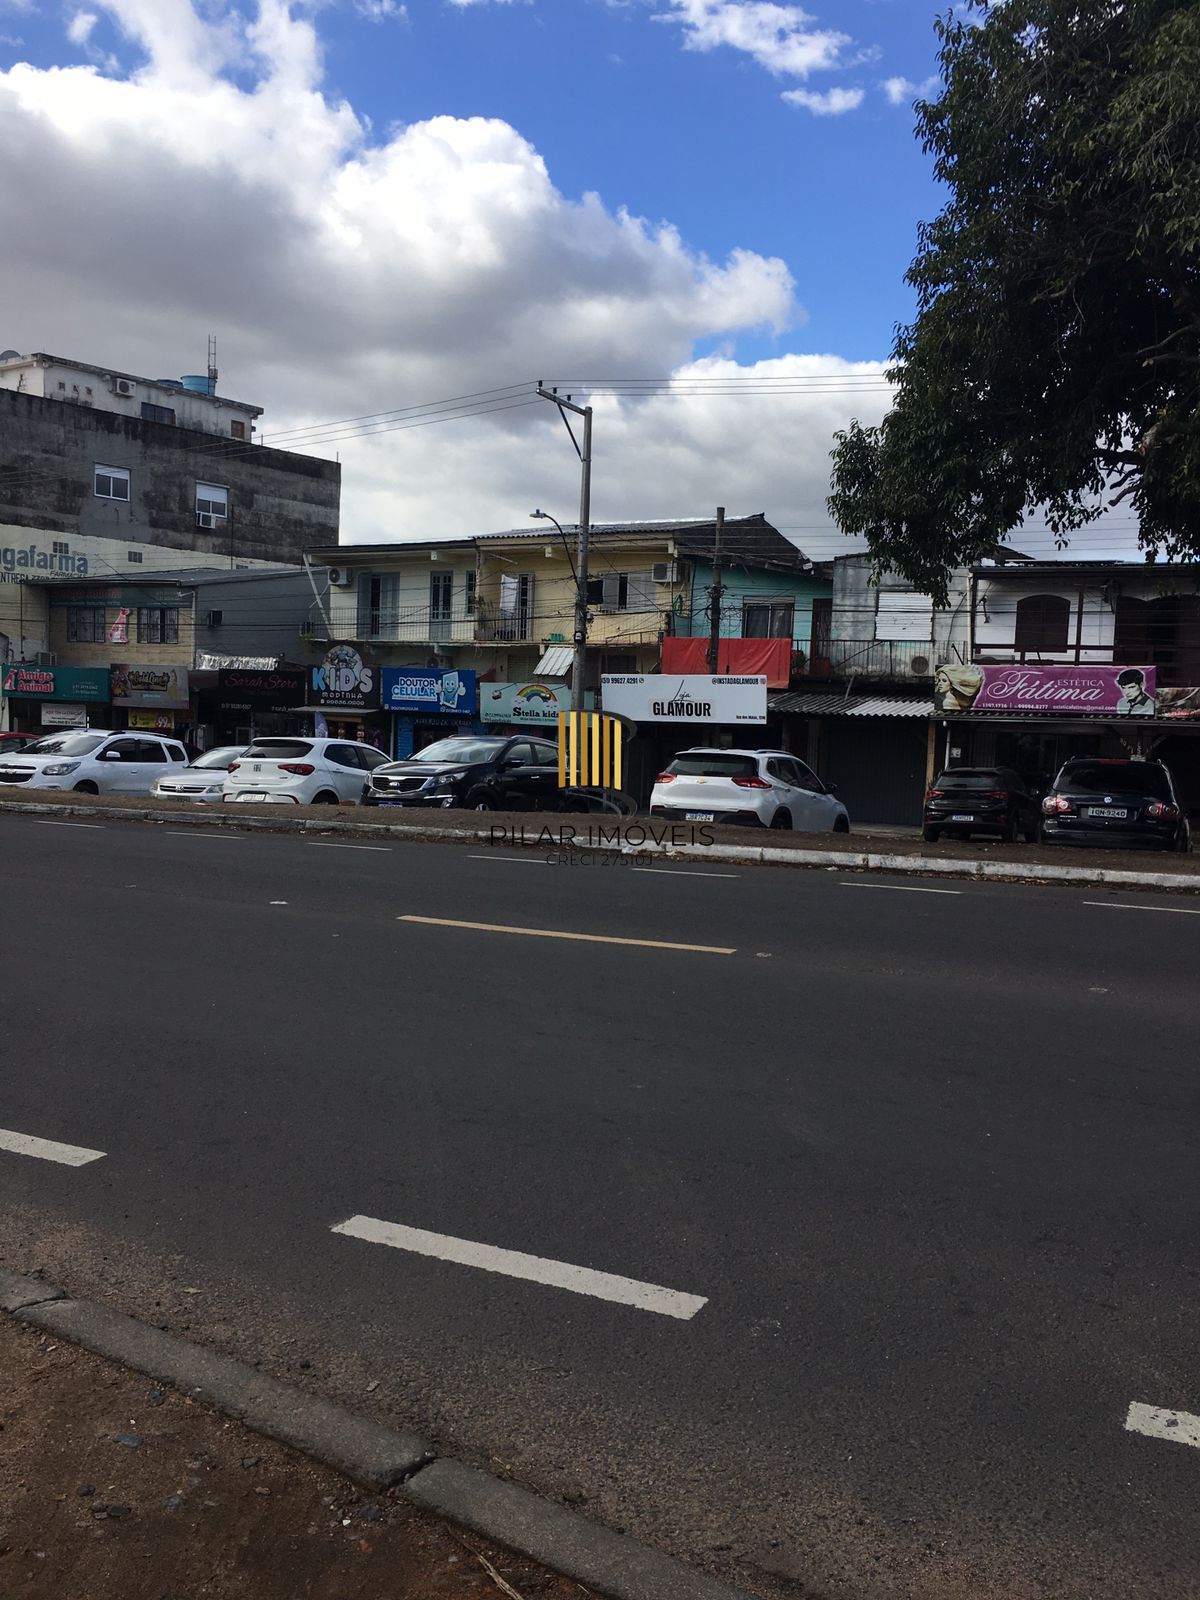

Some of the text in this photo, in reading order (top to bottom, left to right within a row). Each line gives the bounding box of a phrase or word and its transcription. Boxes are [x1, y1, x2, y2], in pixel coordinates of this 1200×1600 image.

[0, 545, 88, 575] gafarma
[17, 669, 54, 683] Amigo
[312, 667, 374, 693] KIDS
[399, 678, 436, 688] DOUTOR
[1057, 678, 1105, 687] ESTÉTICA
[17, 680, 54, 694] Animal
[392, 686, 436, 697] CELULAR
[987, 670, 1105, 701] Fátima
[512, 706, 540, 718] Stella
[653, 701, 711, 717] GLAMOUR
